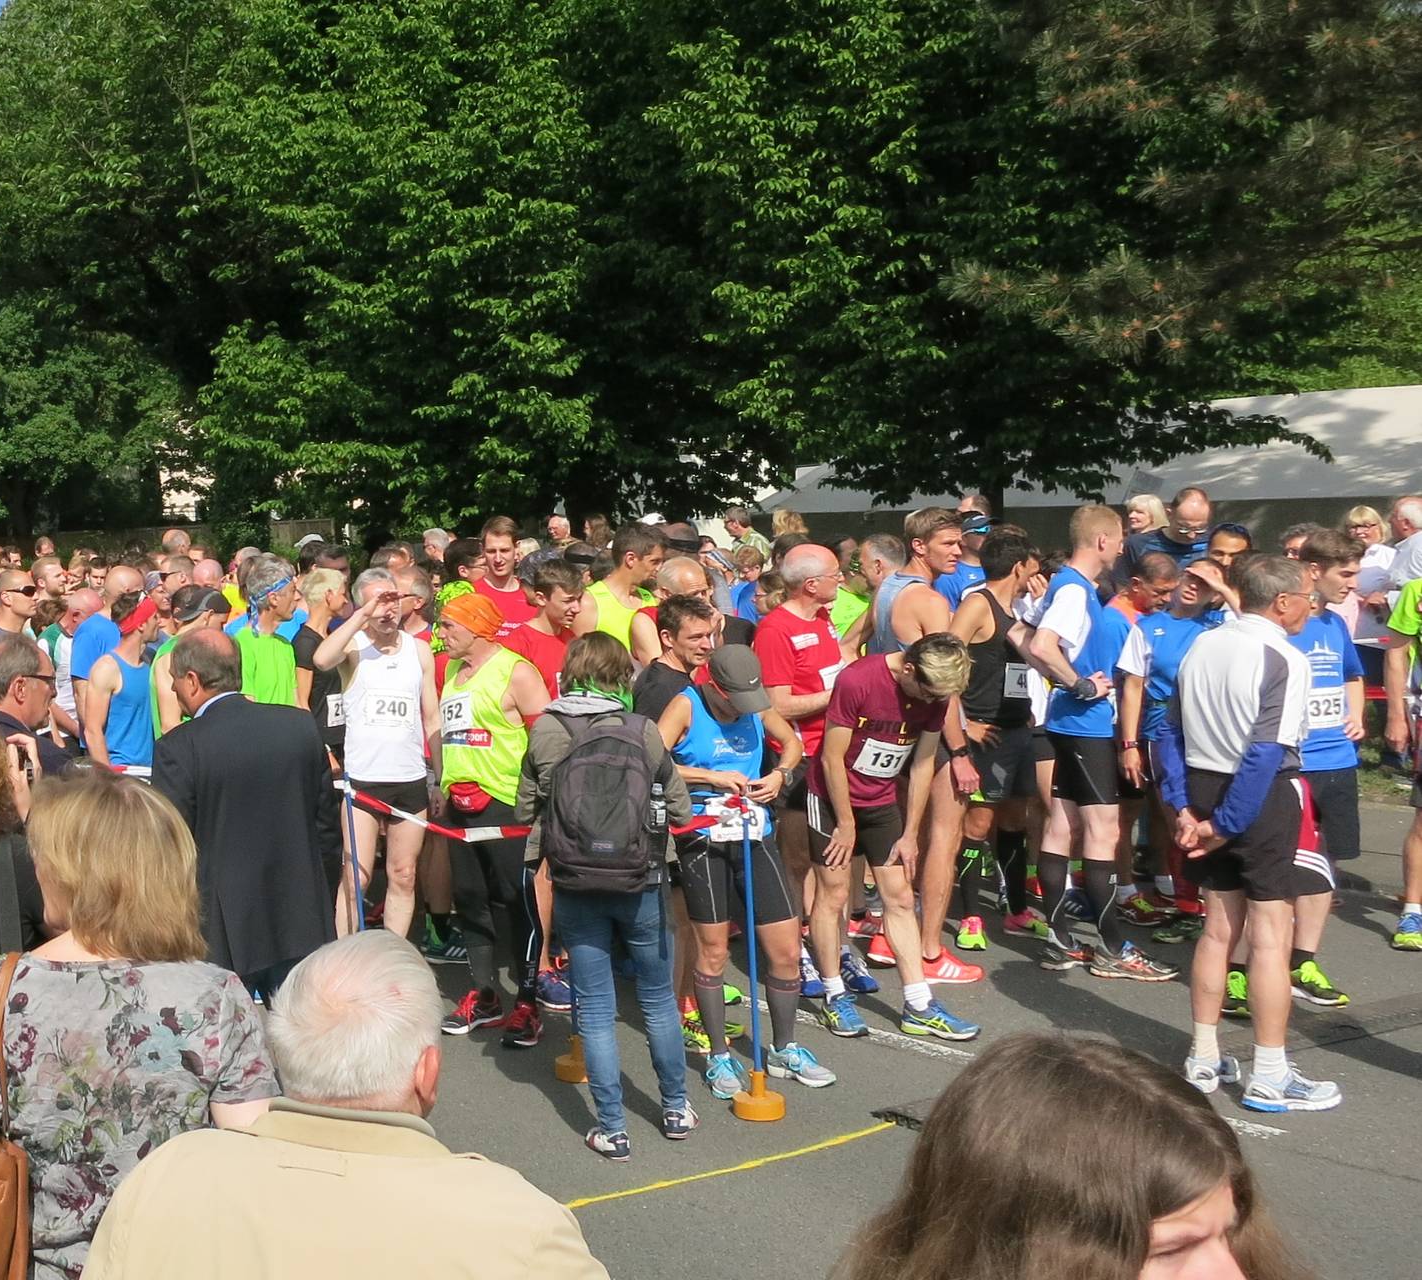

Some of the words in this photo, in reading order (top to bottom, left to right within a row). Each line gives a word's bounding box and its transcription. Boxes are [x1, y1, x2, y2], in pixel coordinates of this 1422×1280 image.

[376, 700, 407, 717] 240
[443, 702, 463, 721] 152
[1309, 698, 1341, 717] 325
[871, 752, 903, 769] 131
